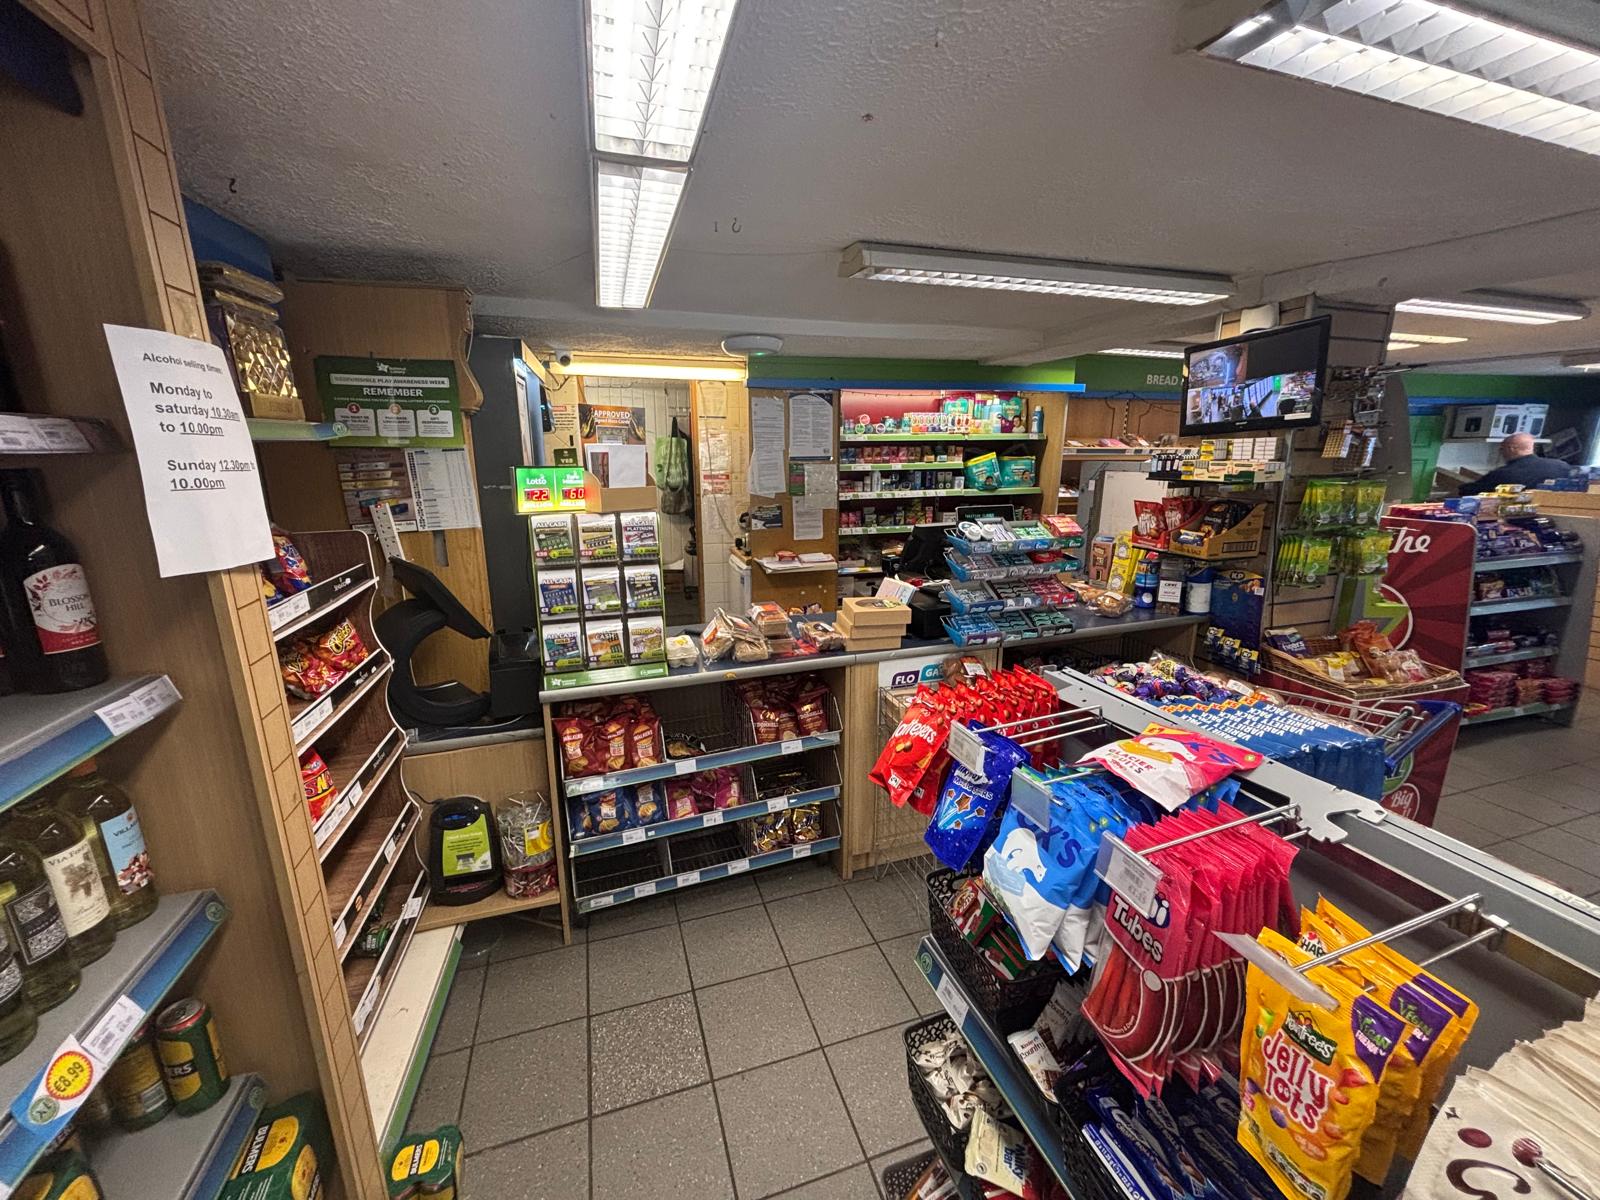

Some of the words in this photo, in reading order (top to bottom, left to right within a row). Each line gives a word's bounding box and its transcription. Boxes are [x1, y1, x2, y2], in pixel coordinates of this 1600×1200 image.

[143, 353, 182, 365] Alcohol
[183, 360, 206, 372] selling
[1146, 374, 1178, 386] BREAD
[150, 382, 200, 400] Monday
[203, 388, 212, 399] to
[363, 388, 423, 397] REMEMBER
[155, 403, 209, 418] saturday
[594, 409, 631, 419] APPROVED
[160, 422, 175, 432] to
[180, 422, 224, 435] 10.00pm
[167, 460, 216, 472] Sunday
[219, 460, 251, 471] 12.30pm
[170, 478, 226, 491] 10.00pm
[526, 477, 547, 485] Lotto
[570, 489, 584, 499] 60
[66, 604, 85, 612] HILL
[895, 674, 915, 685] FLO
[1201, 712, 1226, 723] PACK
[1219, 711, 1245, 723] PACK
[1235, 711, 1260, 722] PACK
[1247, 707, 1273, 719] PACK
[1263, 704, 1289, 716] PACK
[1226, 720, 1265, 737] VARIETY
[1243, 720, 1285, 736] VARIETY
[1261, 718, 1304, 735] VARIETY
[1277, 716, 1315, 731] VARIETY
[1287, 714, 1329, 730] VARIETY
[1107, 753, 1144, 774] FRUITS
[1109, 749, 1152, 770] GLACIER
[1391, 789, 1414, 809] Big
[1113, 893, 1164, 964] Tubes
[1019, 1042, 1047, 1059] Country
[53, 1061, 84, 1093] €8.99
[1263, 1030, 1330, 1111] Jelly
[1265, 1061, 1319, 1130] Tots
[242, 1125, 270, 1174] BULMERS
